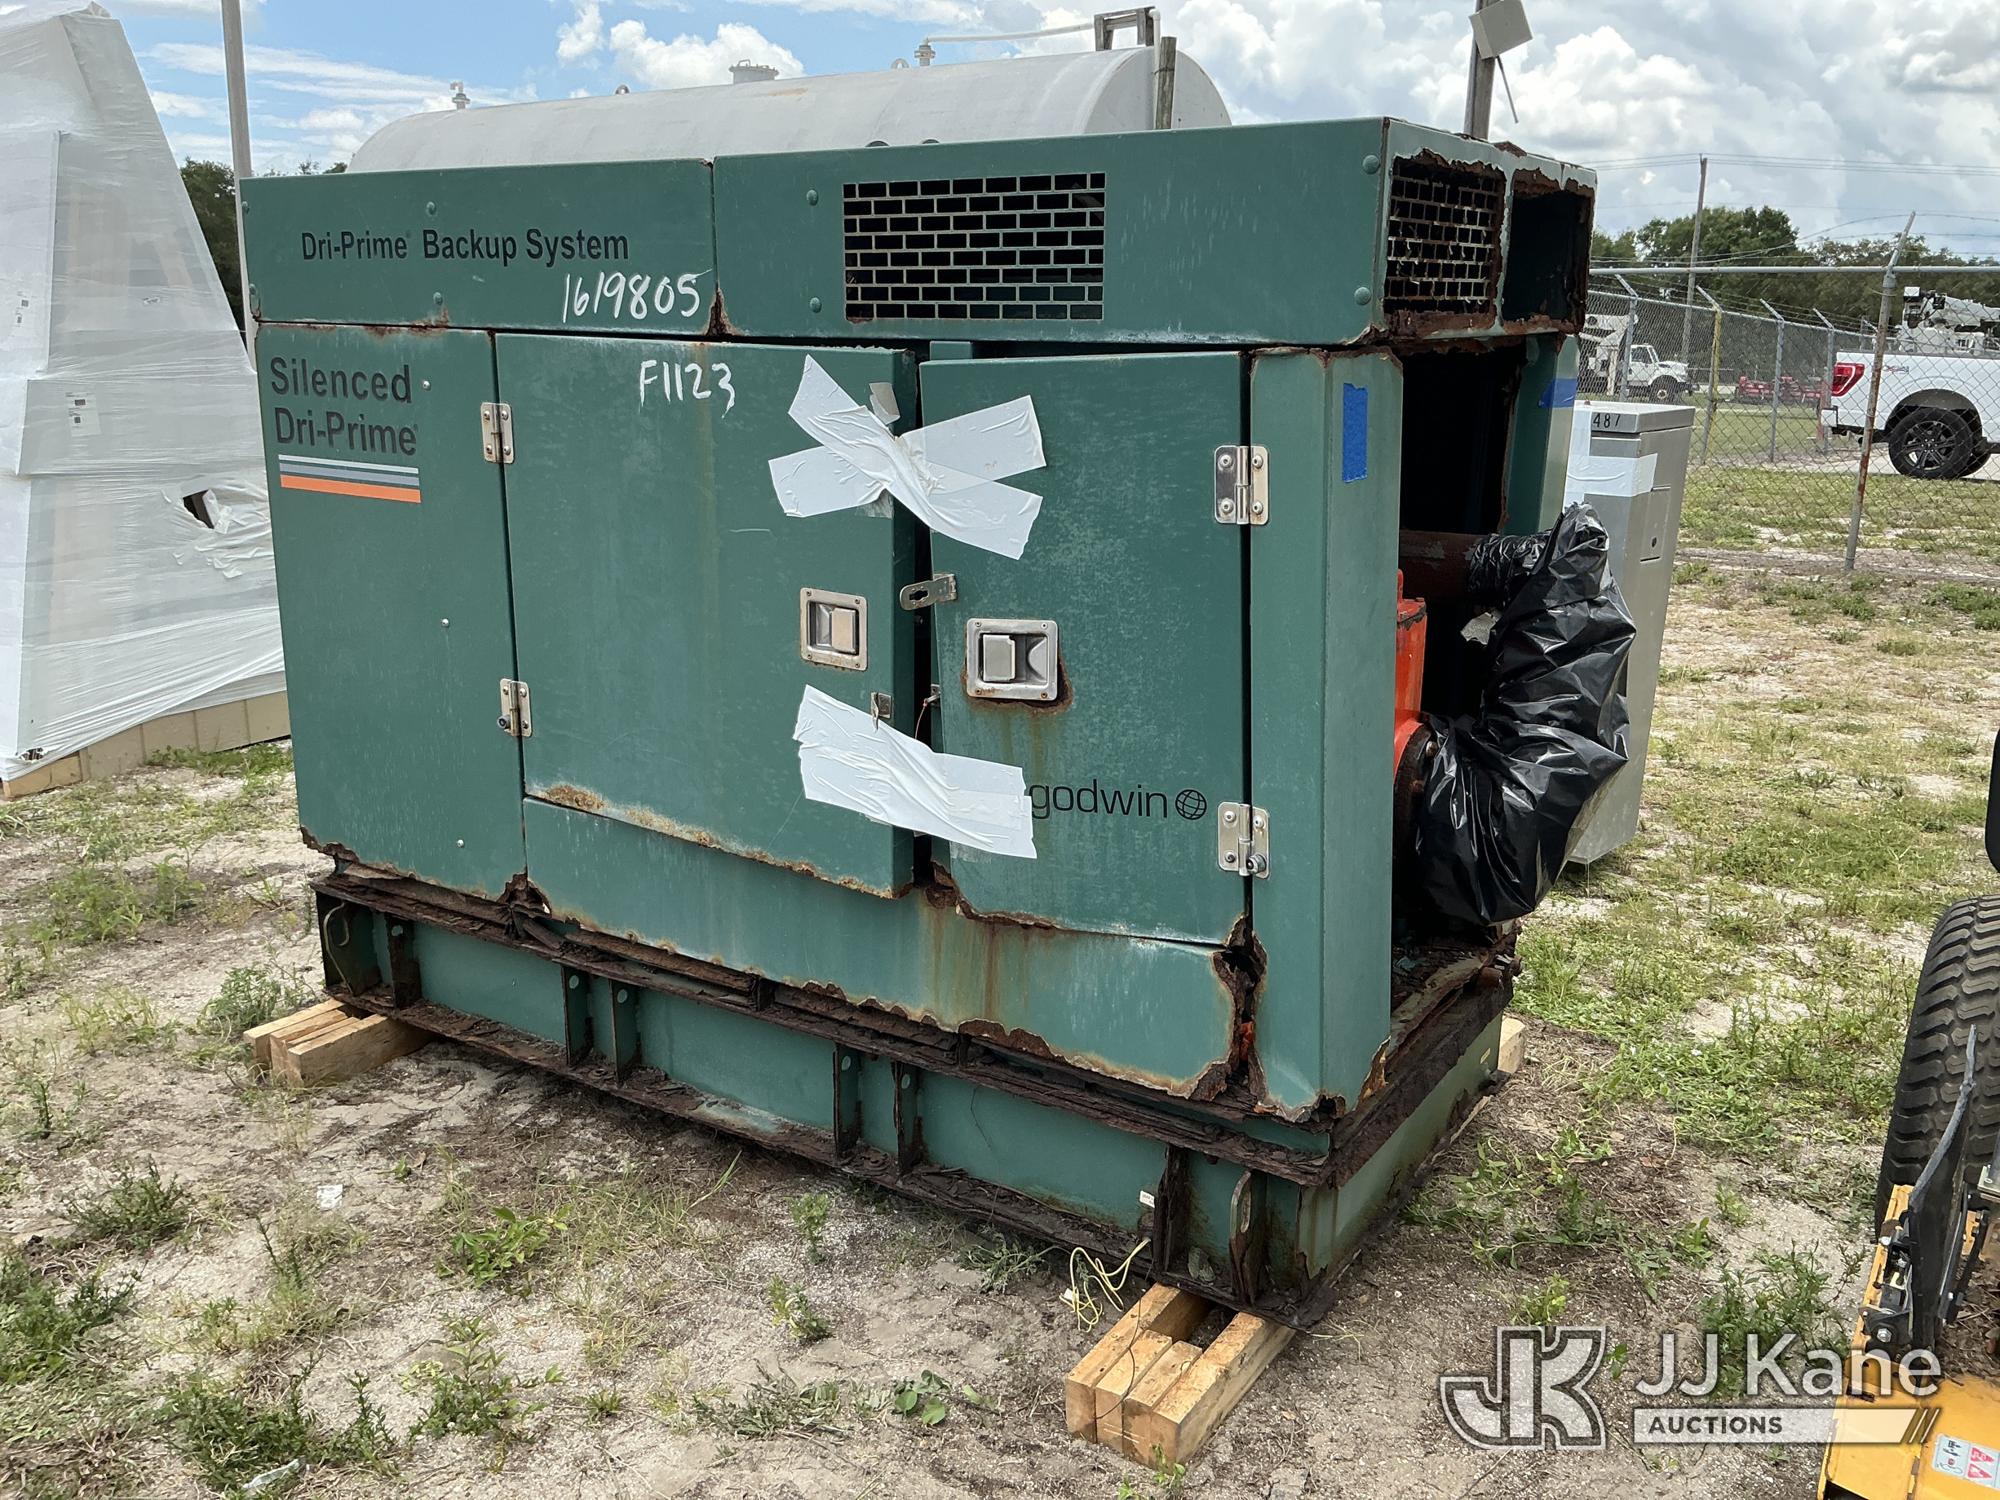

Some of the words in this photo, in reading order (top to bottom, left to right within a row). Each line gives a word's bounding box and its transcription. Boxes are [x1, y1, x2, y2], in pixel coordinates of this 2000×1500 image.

[301, 230, 408, 261] Dri-Prime
[422, 228, 518, 267] Backup
[525, 227, 630, 267] System
[561, 268, 713, 324] 1619805
[270, 356, 413, 404] Silenced
[638, 359, 736, 419] F1123
[274, 407, 417, 456] Dri-Prime
[1592, 412, 1621, 428] 487
[1028, 778, 1168, 820] godwin
